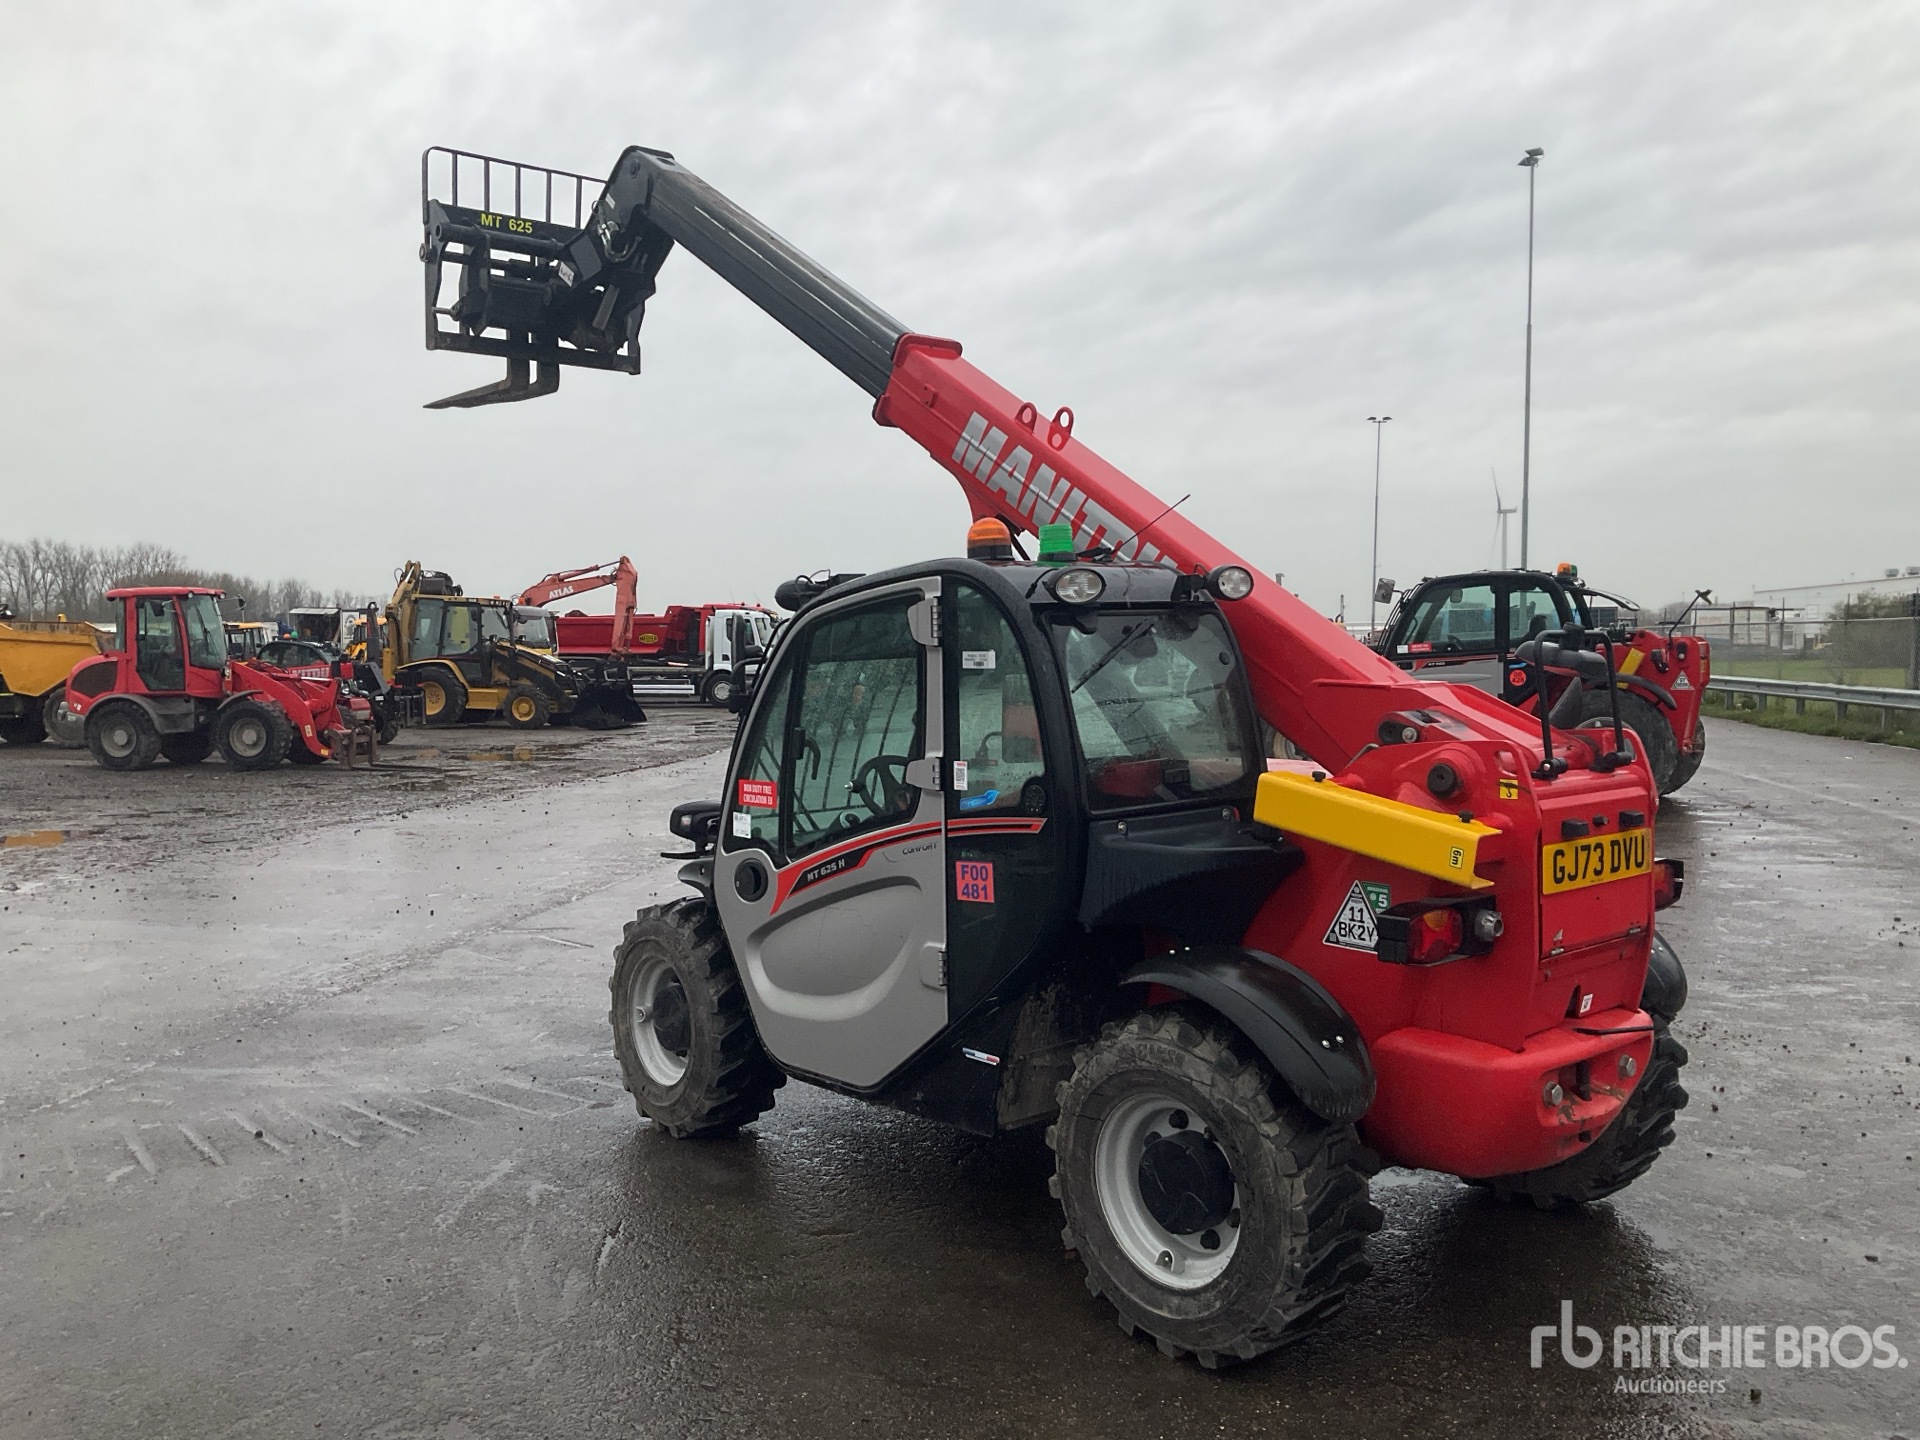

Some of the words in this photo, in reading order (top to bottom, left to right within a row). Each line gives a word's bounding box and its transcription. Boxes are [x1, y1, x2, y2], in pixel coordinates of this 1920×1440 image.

[481, 213, 502, 228] MT
[509, 218, 533, 234] 625
[951, 411, 1178, 569] MANITO
[549, 585, 574, 599] ATLAS
[1451, 850, 1462, 866] 6m
[1552, 842, 1605, 885] GJ73
[1610, 835, 1645, 874] DVU
[807, 868, 820, 882] MT
[820, 862, 837, 876] 625
[838, 858, 846, 868] H
[960, 864, 989, 882] F00
[961, 882, 988, 900] 481
[1378, 893, 1388, 908] 5
[1348, 906, 1365, 924] 11
[1338, 921, 1375, 943] BK2Y
